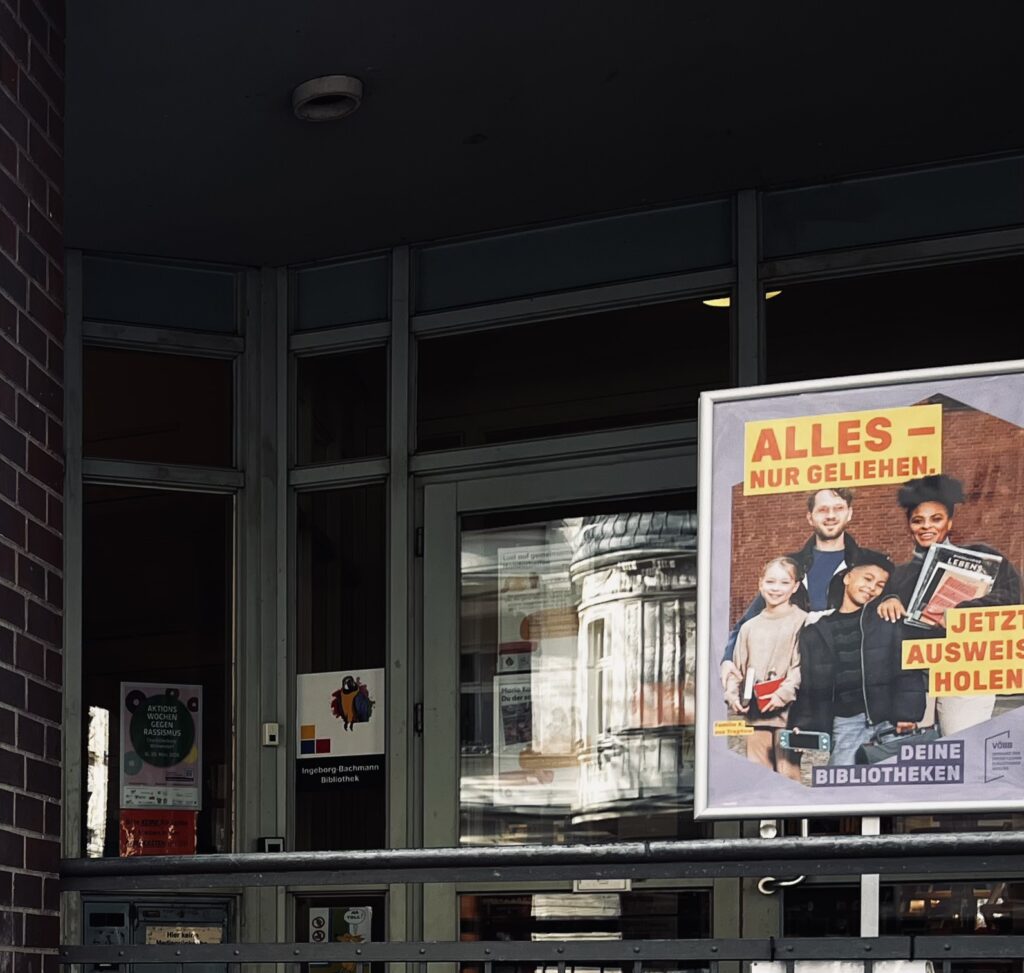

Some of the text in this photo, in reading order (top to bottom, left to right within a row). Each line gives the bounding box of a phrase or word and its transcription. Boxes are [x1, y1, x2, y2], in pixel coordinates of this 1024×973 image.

[751, 416, 893, 463] ALLES
[750, 456, 936, 489] NUR GELIEHEN.
[934, 668, 1023, 692] HOLEN
[146, 713, 178, 721] WOCHEN
[147, 705, 178, 713] AKTIONS
[143, 728, 183, 737] RASSISMUS
[901, 743, 961, 762] DEINE
[320, 775, 360, 784] Bibliothek
[815, 764, 961, 785] BIBLIOTHEKEN
